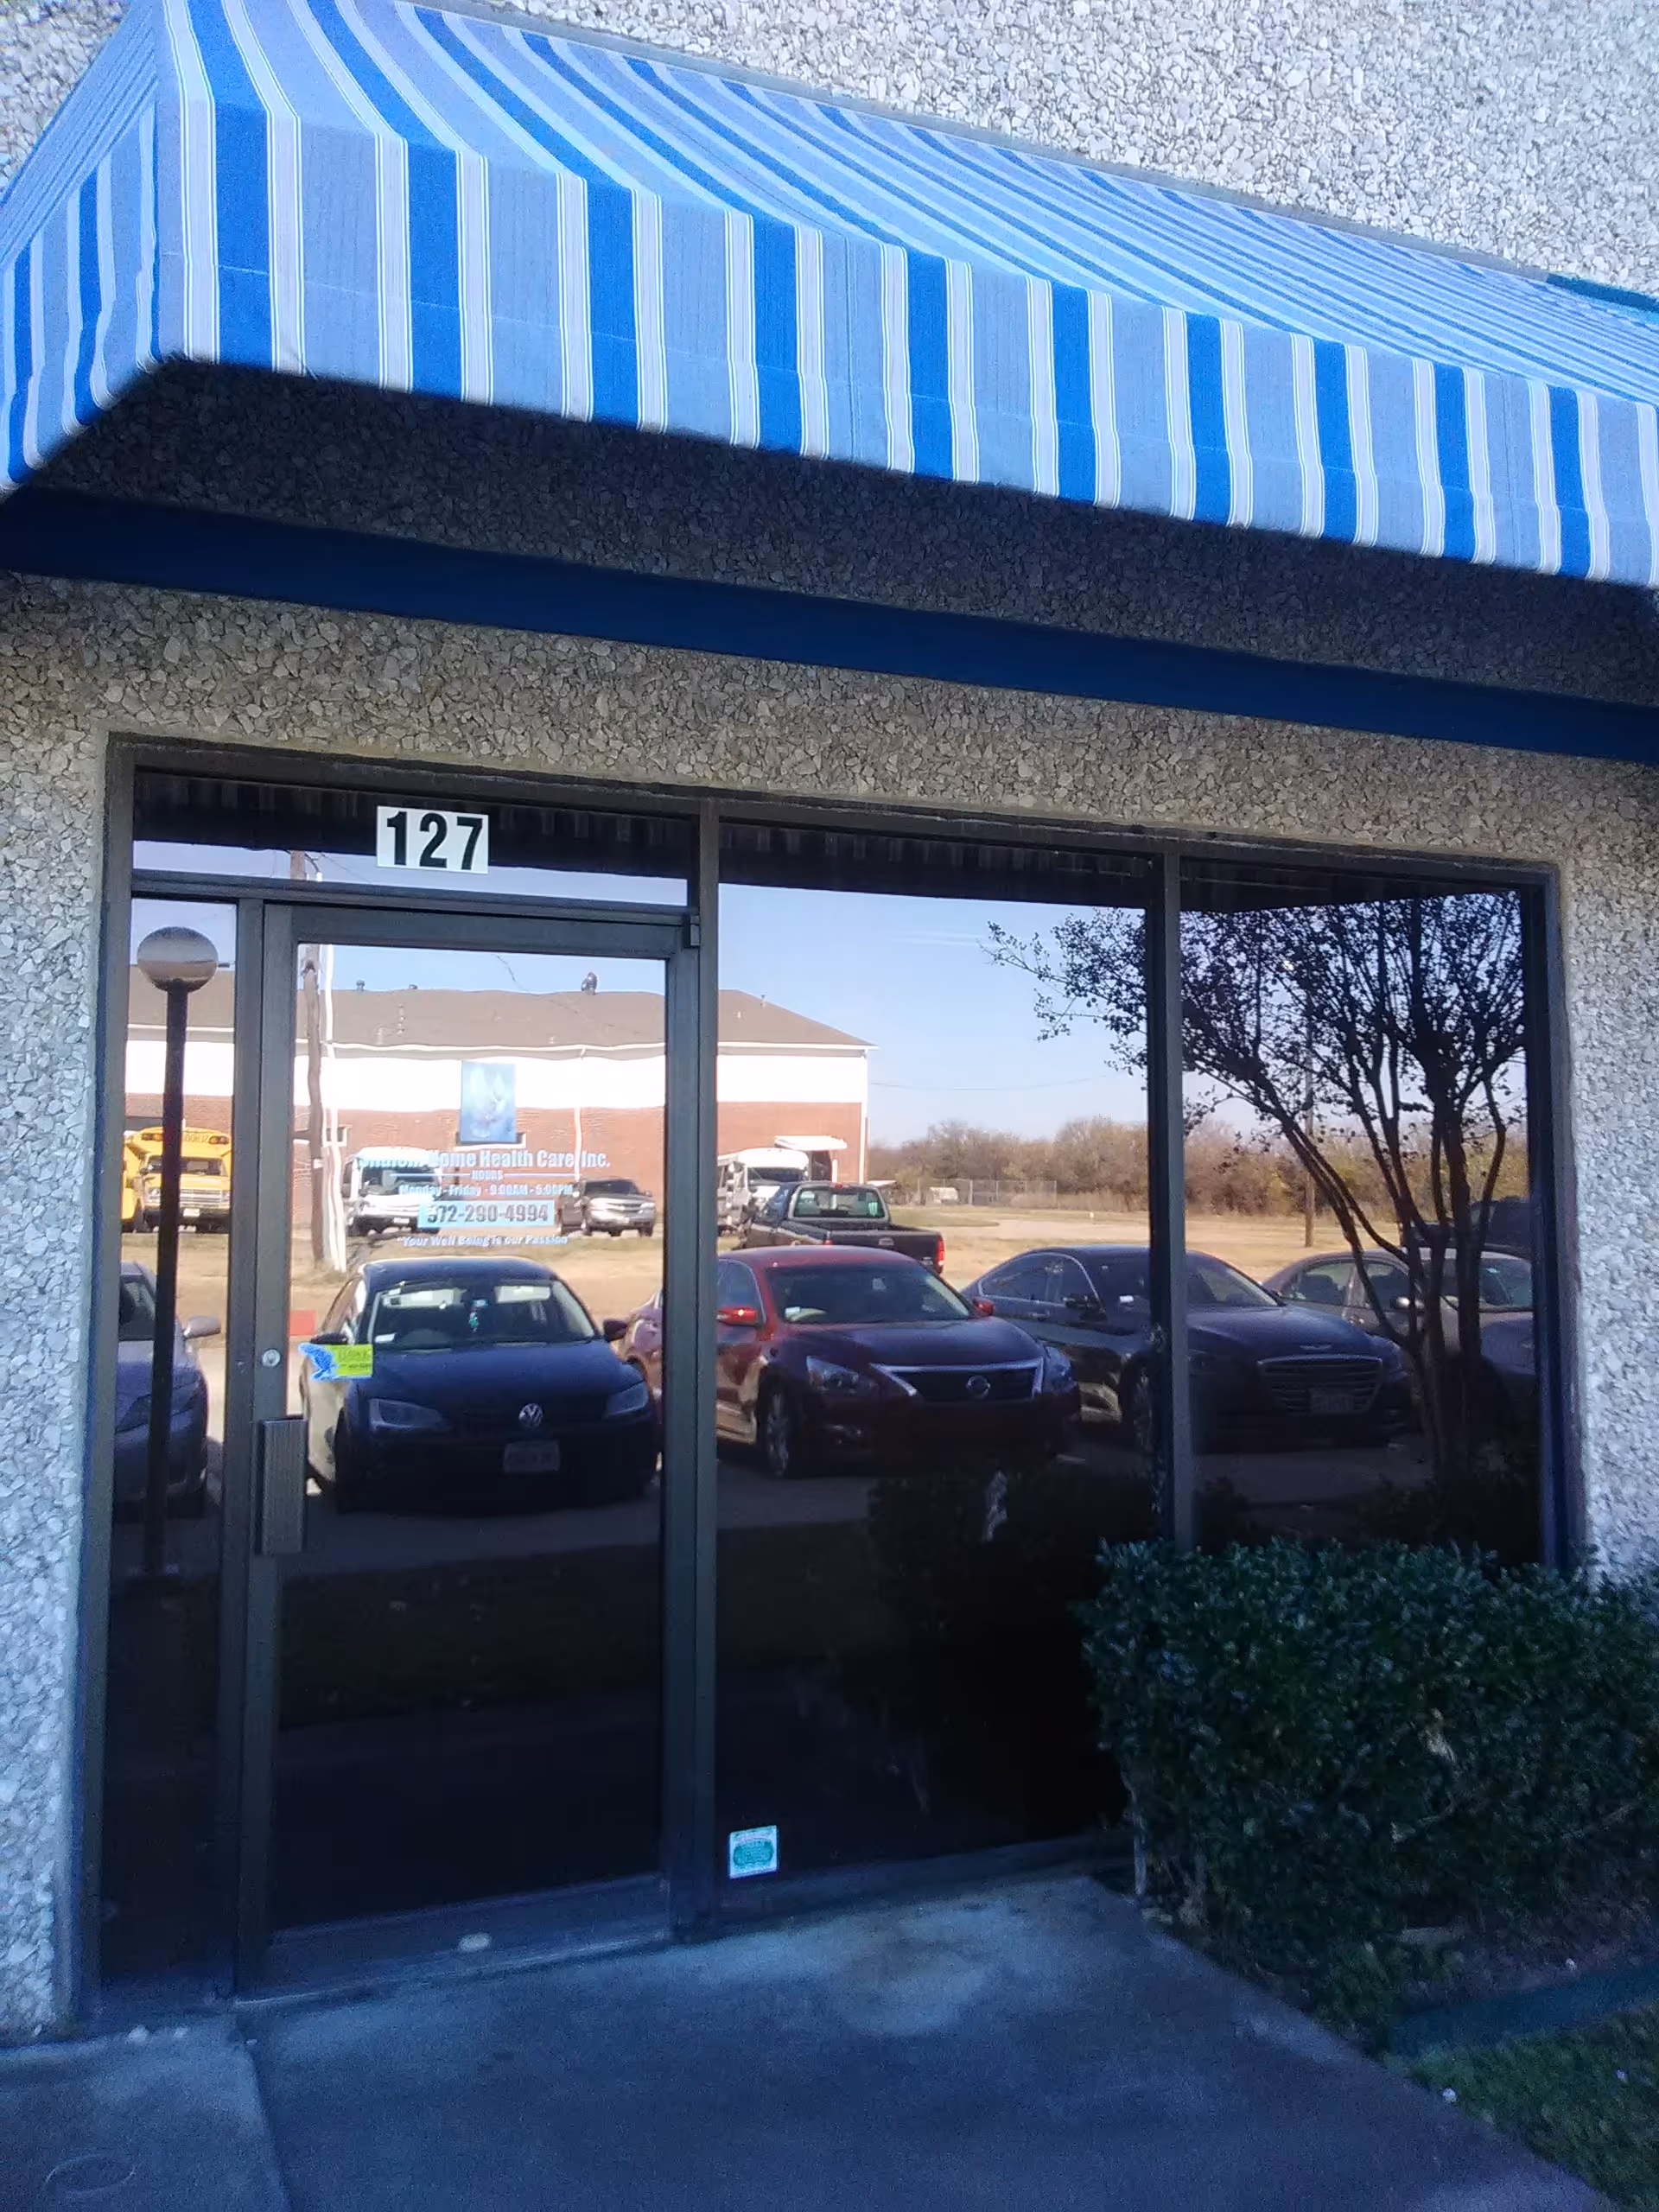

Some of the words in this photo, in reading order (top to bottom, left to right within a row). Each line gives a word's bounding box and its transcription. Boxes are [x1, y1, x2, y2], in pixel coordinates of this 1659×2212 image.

[387, 810, 483, 870] 127
[429, 1150, 477, 1167] Home
[480, 1149, 533, 1167] Health
[537, 1149, 575, 1167] Care
[582, 1150, 610, 1167] Inc.
[398, 1184, 442, 1197] Monday
[449, 1184, 481, 1197] Friday
[430, 1235, 455, 1246] Well
[504, 1236, 522, 1245] our
